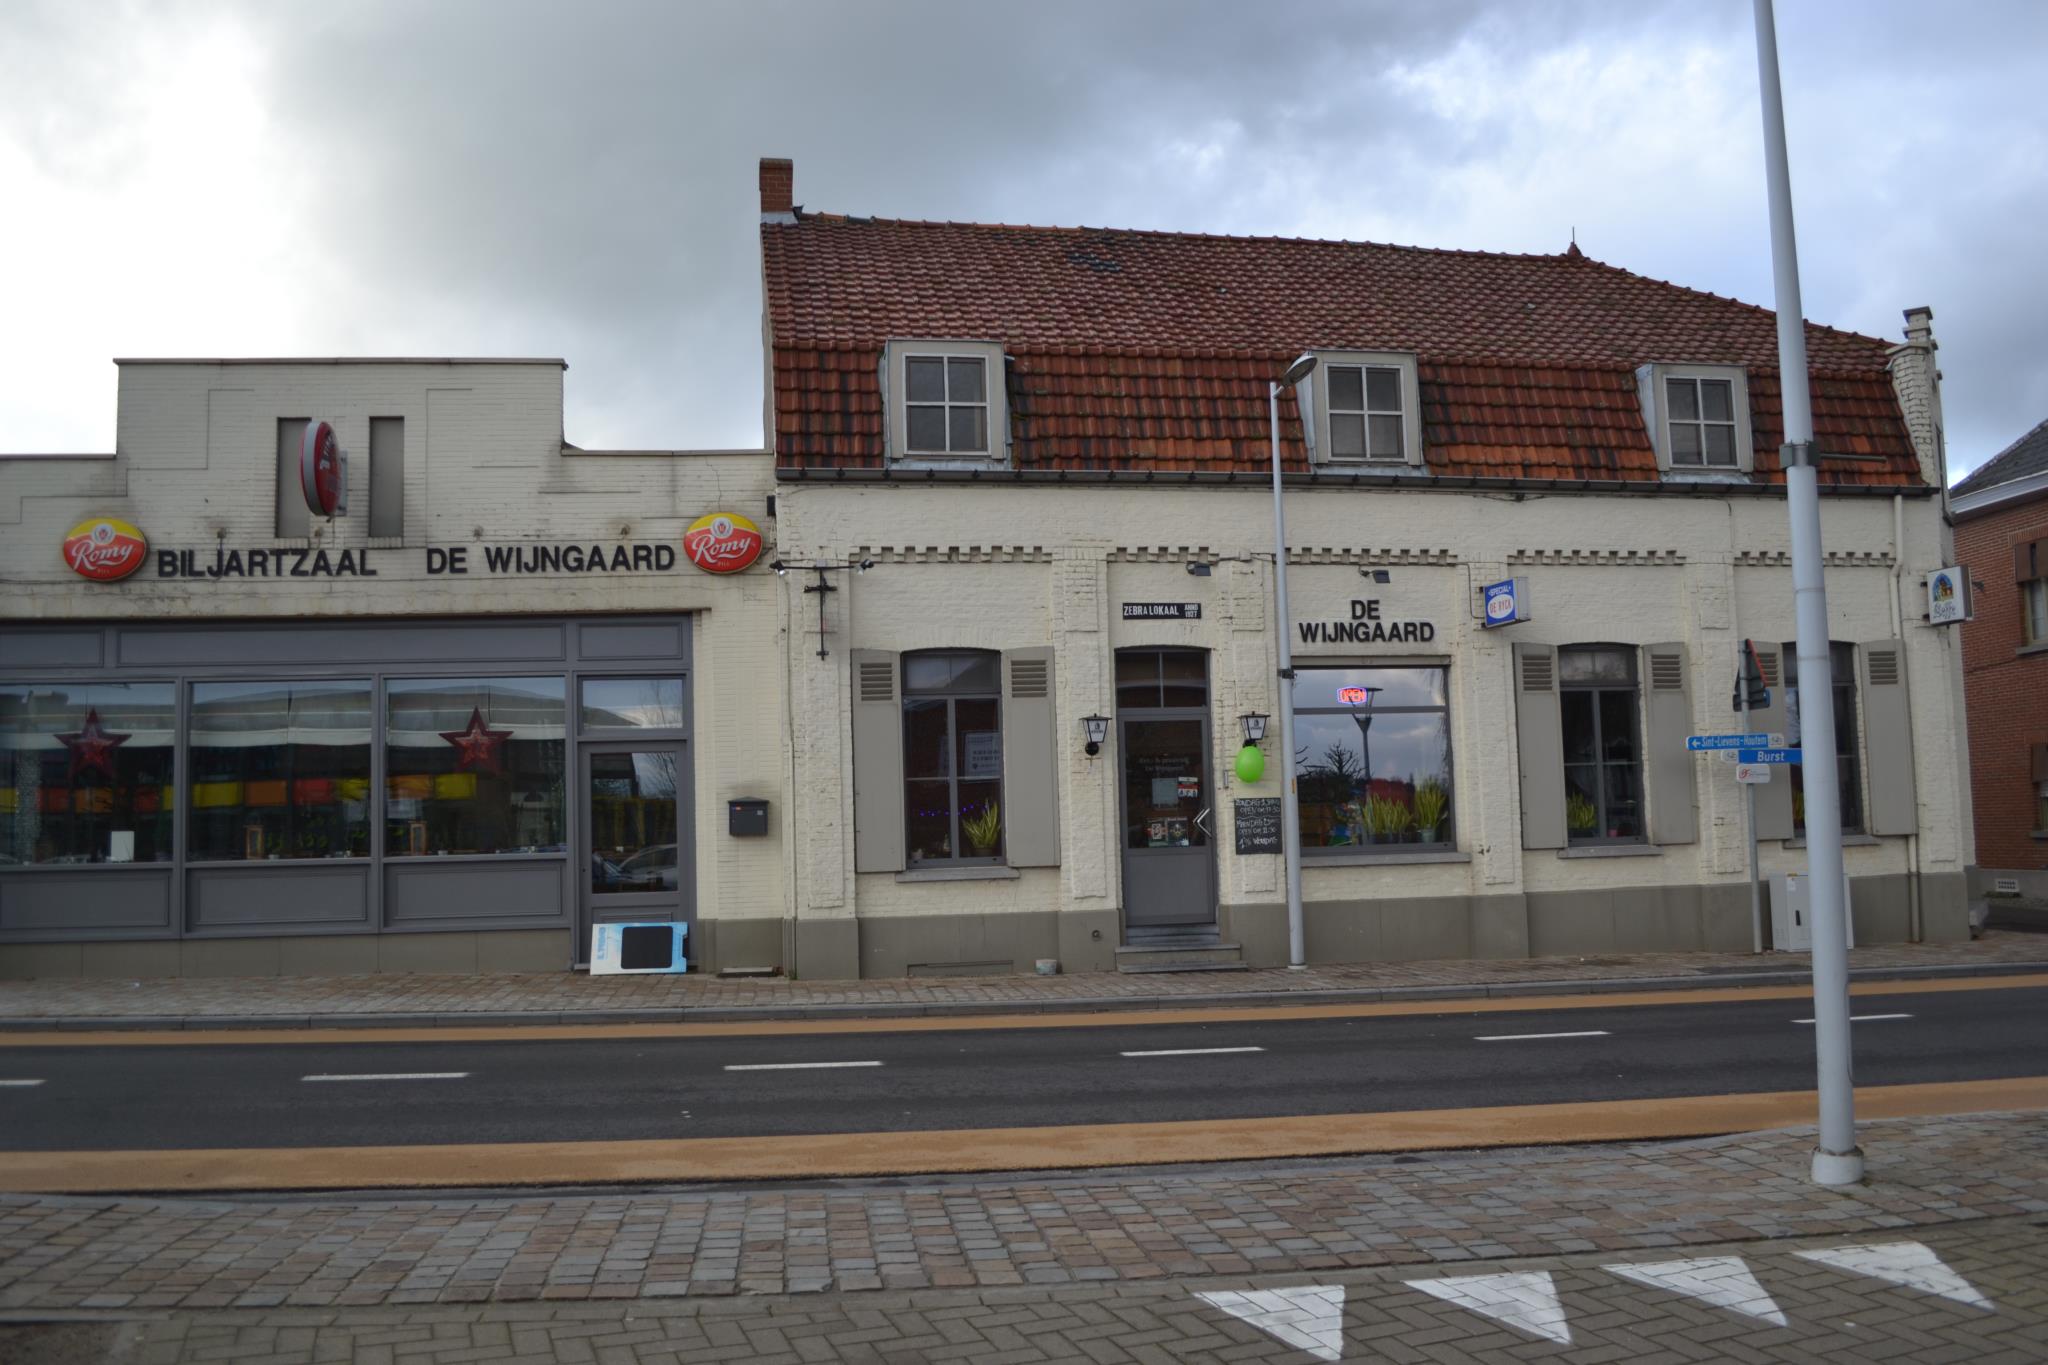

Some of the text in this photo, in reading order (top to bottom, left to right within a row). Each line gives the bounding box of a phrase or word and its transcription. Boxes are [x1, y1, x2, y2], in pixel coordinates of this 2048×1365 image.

[71, 539, 133, 571] Romy
[692, 534, 751, 564] Romy
[158, 545, 675, 578] BILJARTZAAL DE WIJNGAARD
[1490, 584, 1510, 597] SPECIAL
[1123, 605, 1179, 616] ZEBRA LOKAAL
[1184, 603, 1198, 611] ANNO
[1351, 600, 1380, 620] DE
[1490, 602, 1497, 614] DE
[1299, 622, 1434, 643] WIJNGAARD
[1339, 687, 1366, 702] OPEN
[1701, 735, 1767, 747] Sint-Lievens-Houtem
[1757, 751, 1785, 762] Burst
